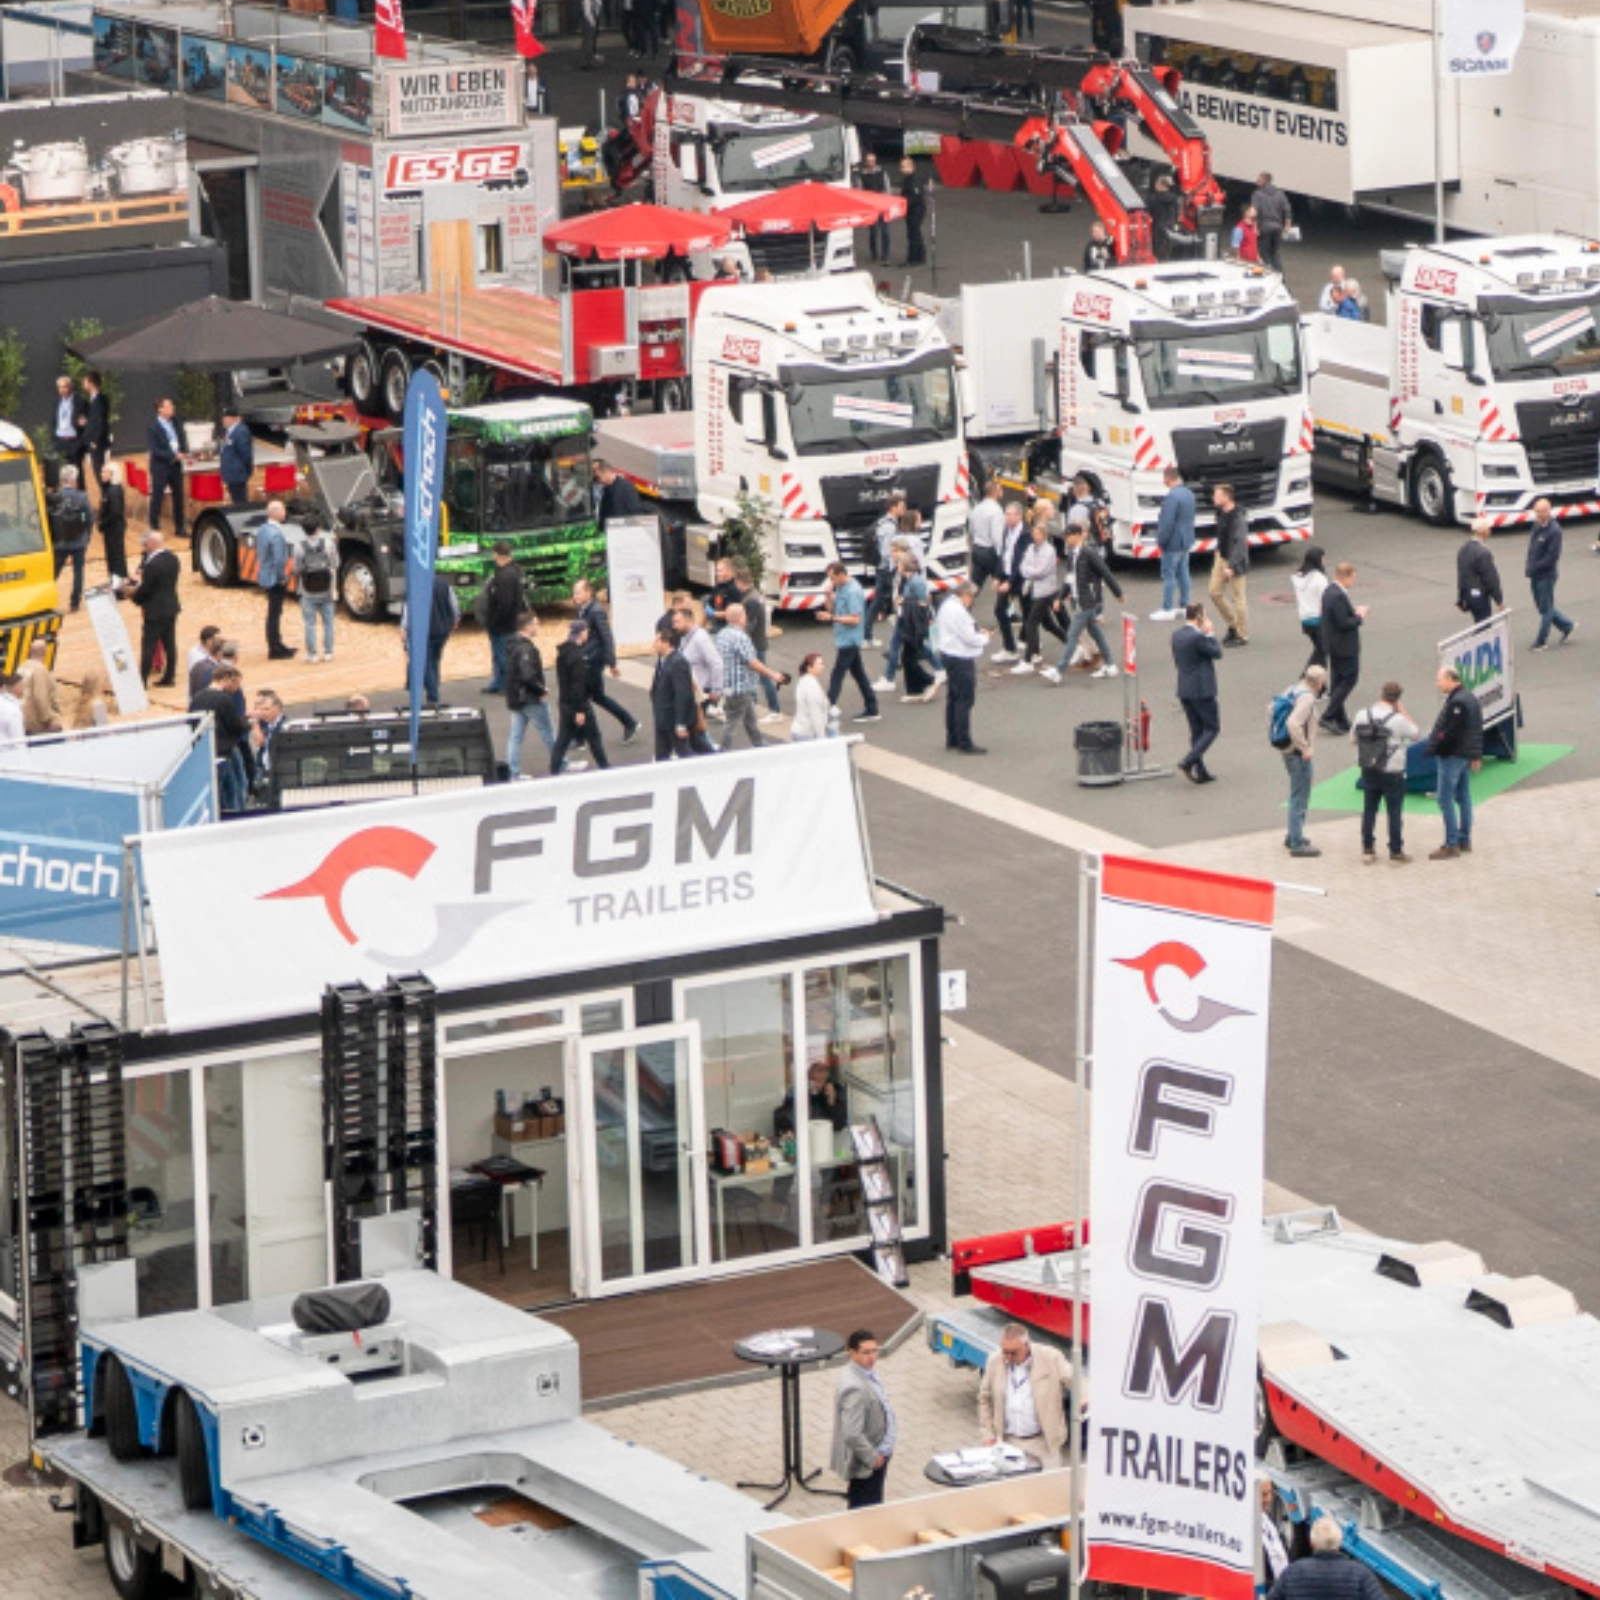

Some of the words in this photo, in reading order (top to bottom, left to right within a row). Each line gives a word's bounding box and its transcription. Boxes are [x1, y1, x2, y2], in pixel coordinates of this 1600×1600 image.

[400, 73, 440, 98] WIR
[446, 68, 506, 93] LEBEN
[1196, 93, 1272, 131] BEWEGT
[1274, 108, 1348, 147] EVENTS
[473, 777, 755, 895] FGM
[568, 871, 755, 927] TRAILERS
[1128, 1057, 1236, 1414] FGM
[1100, 1426, 1248, 1502] TRAILERS
[1098, 1511, 1243, 1554] www.fgm-trailers.eu
